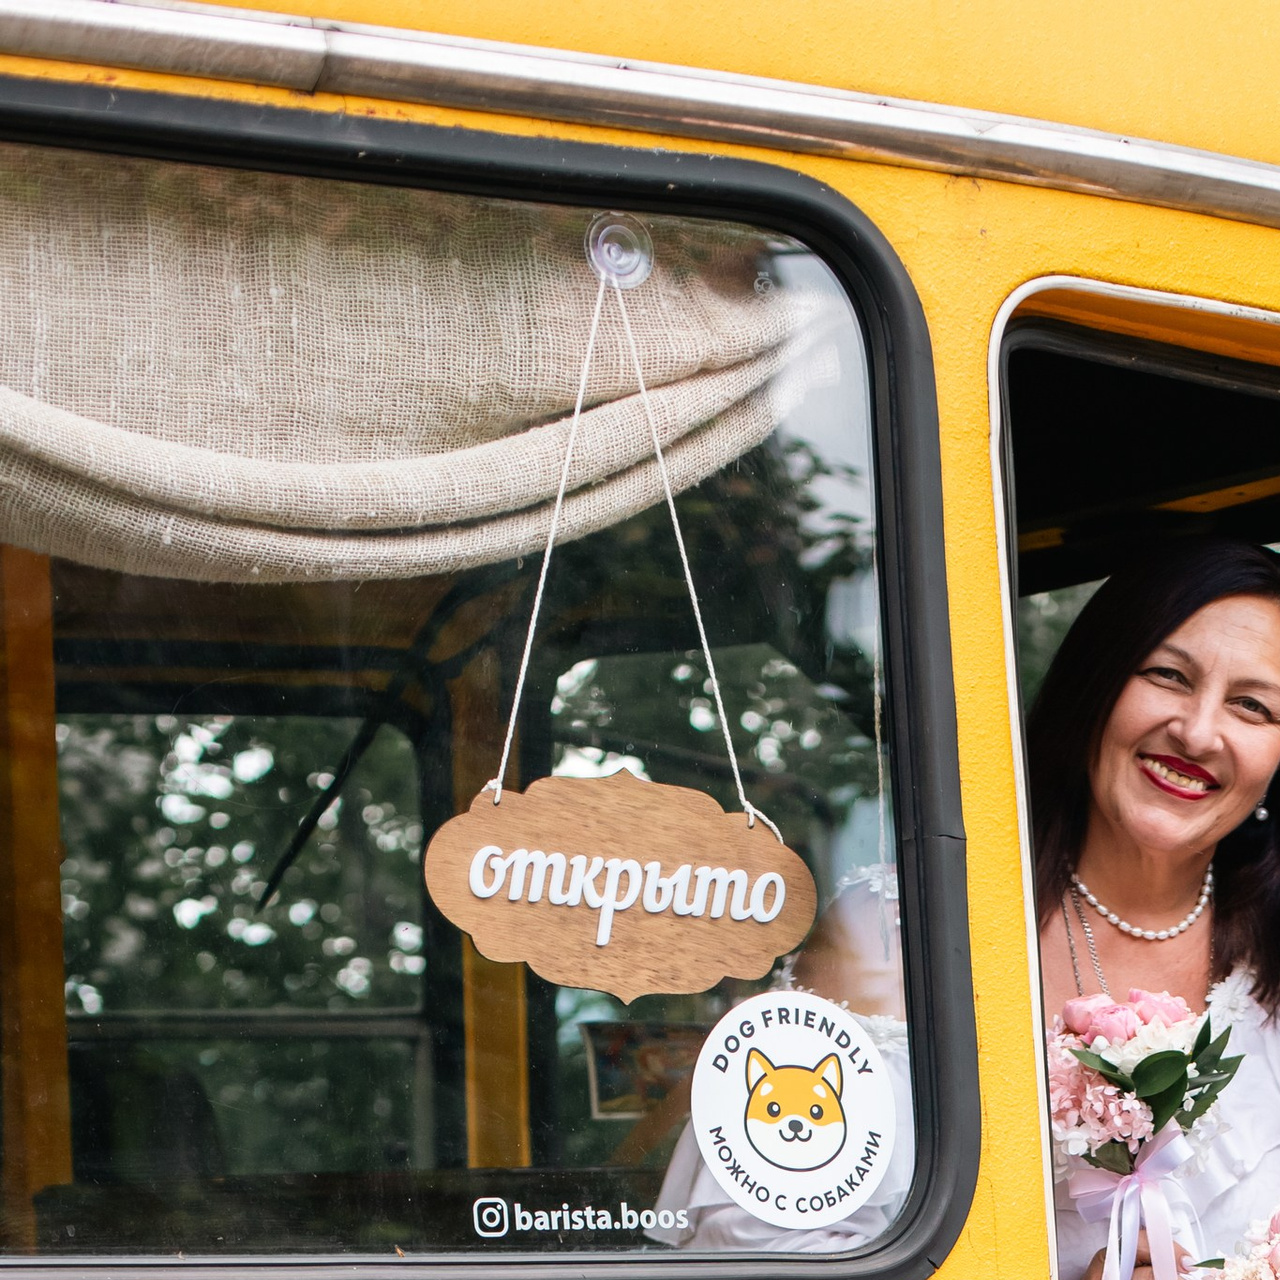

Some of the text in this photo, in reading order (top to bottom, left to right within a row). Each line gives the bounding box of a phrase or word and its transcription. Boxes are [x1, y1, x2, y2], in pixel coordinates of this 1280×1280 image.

[469, 845, 786, 947] открыто
[712, 1007, 874, 1076] DOG FRIENDLY
[709, 1126, 882, 1213] МОЖНО С СОБАКАМИ
[515, 1202, 689, 1231] barista.boos
